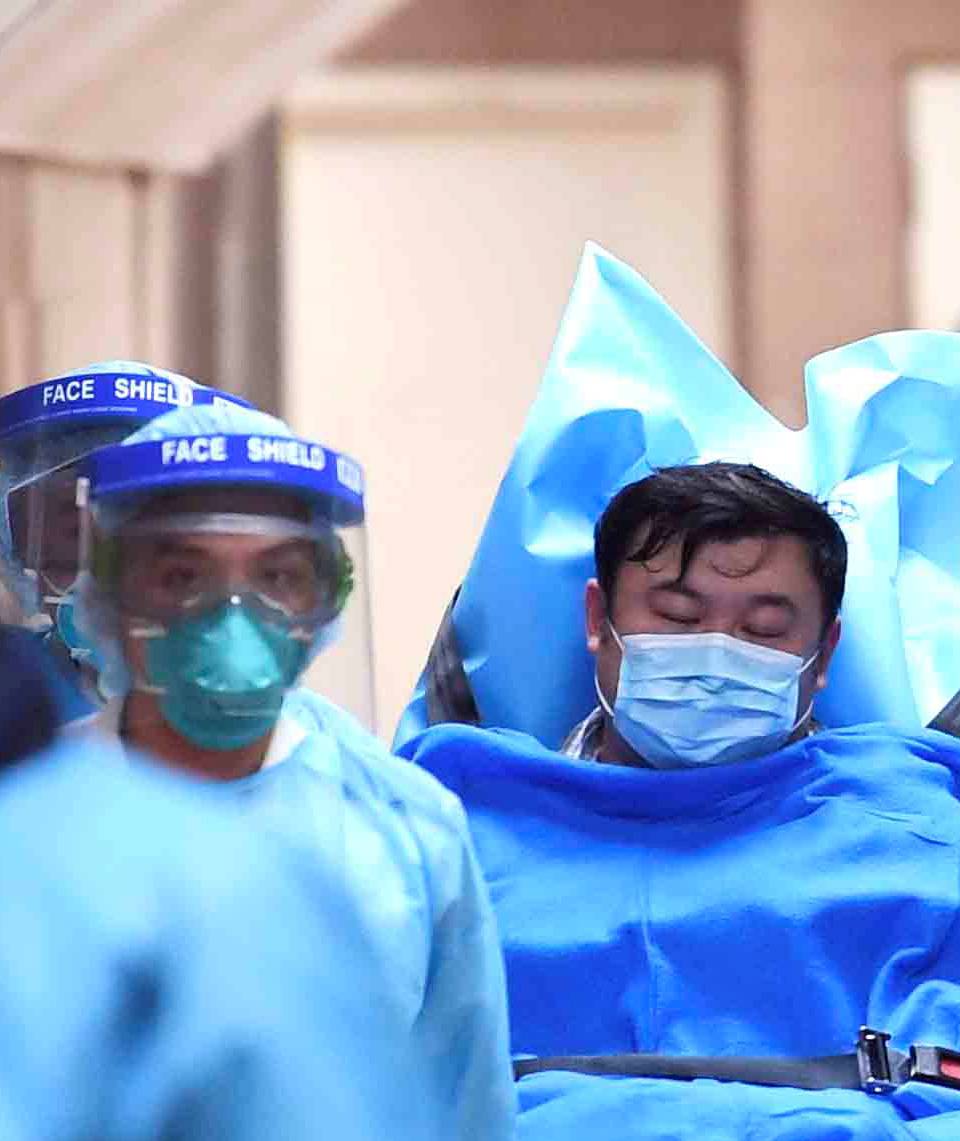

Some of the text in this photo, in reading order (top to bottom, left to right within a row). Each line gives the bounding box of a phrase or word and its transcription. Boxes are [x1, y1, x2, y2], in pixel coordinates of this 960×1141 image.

[43, 378, 194, 407] FACE SHIELD
[161, 437, 326, 471] FACE SHIELD
